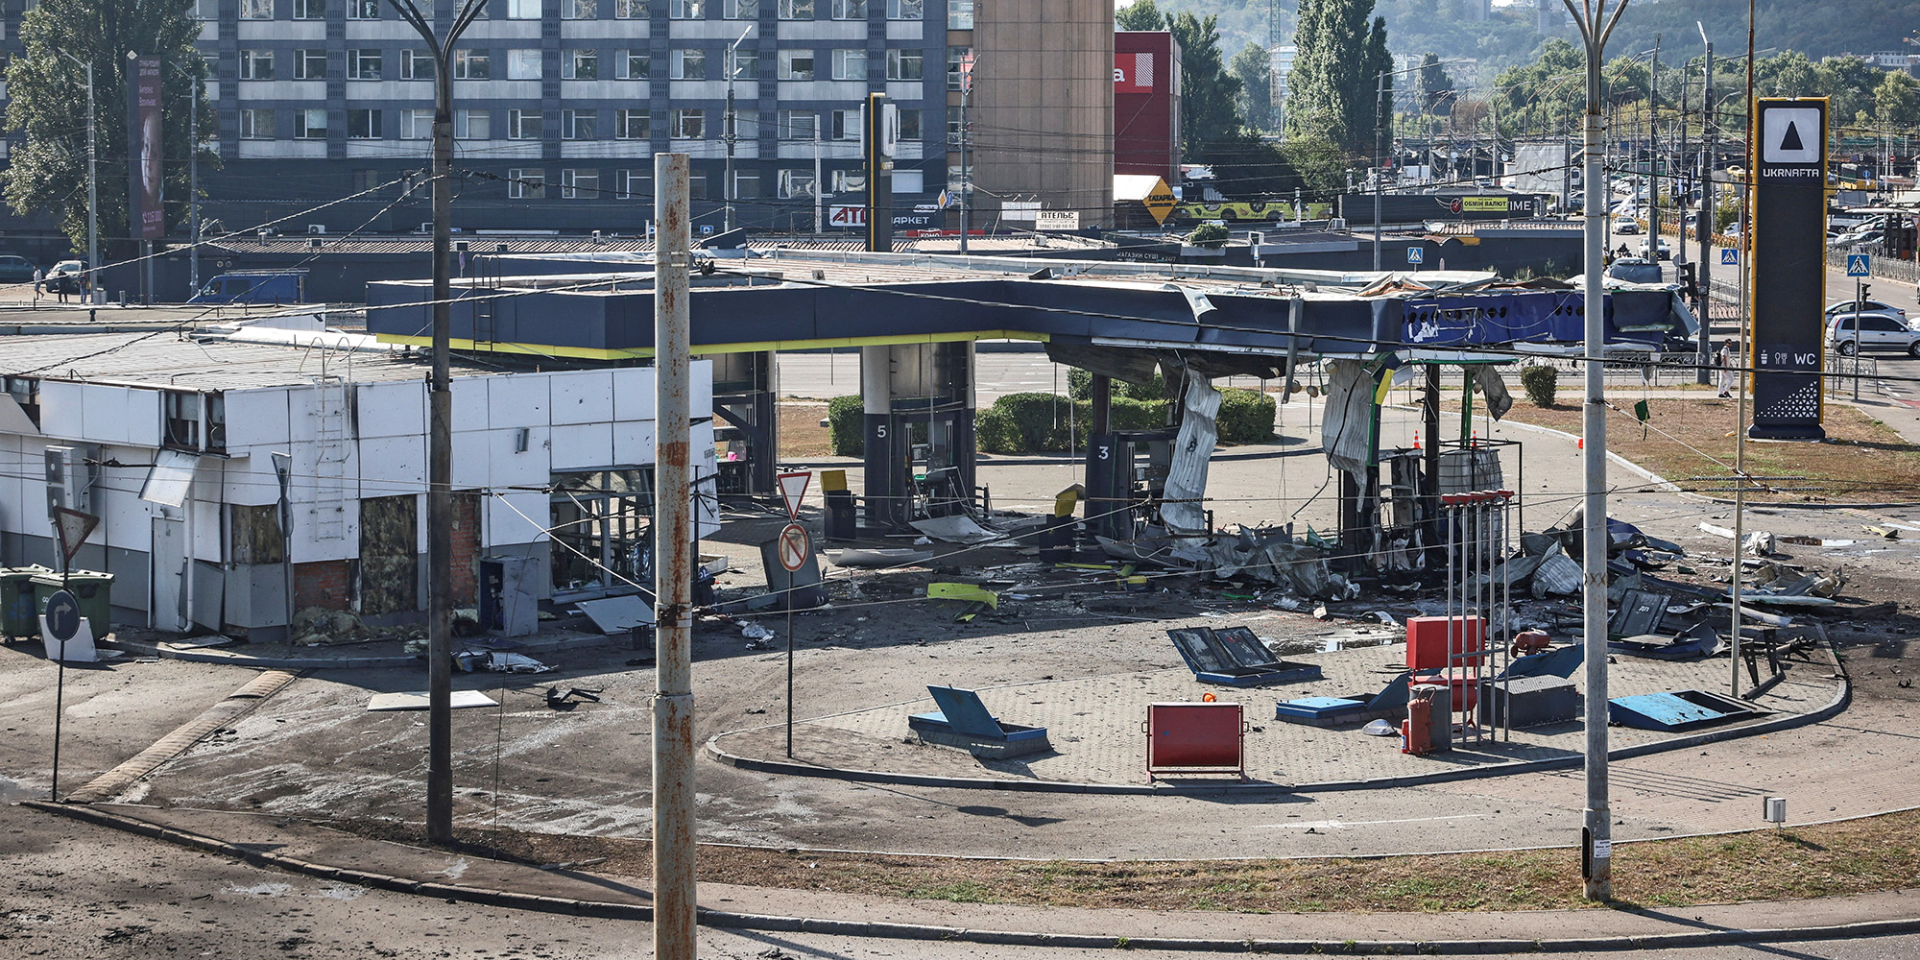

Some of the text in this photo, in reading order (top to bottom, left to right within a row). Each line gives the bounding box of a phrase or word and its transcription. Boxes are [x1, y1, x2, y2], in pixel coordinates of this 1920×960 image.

[1763, 168, 1819, 178] UKRNAFTA
[1794, 353, 1816, 365] WC
[877, 425, 887, 438] 5
[1098, 446, 1109, 460] 3
